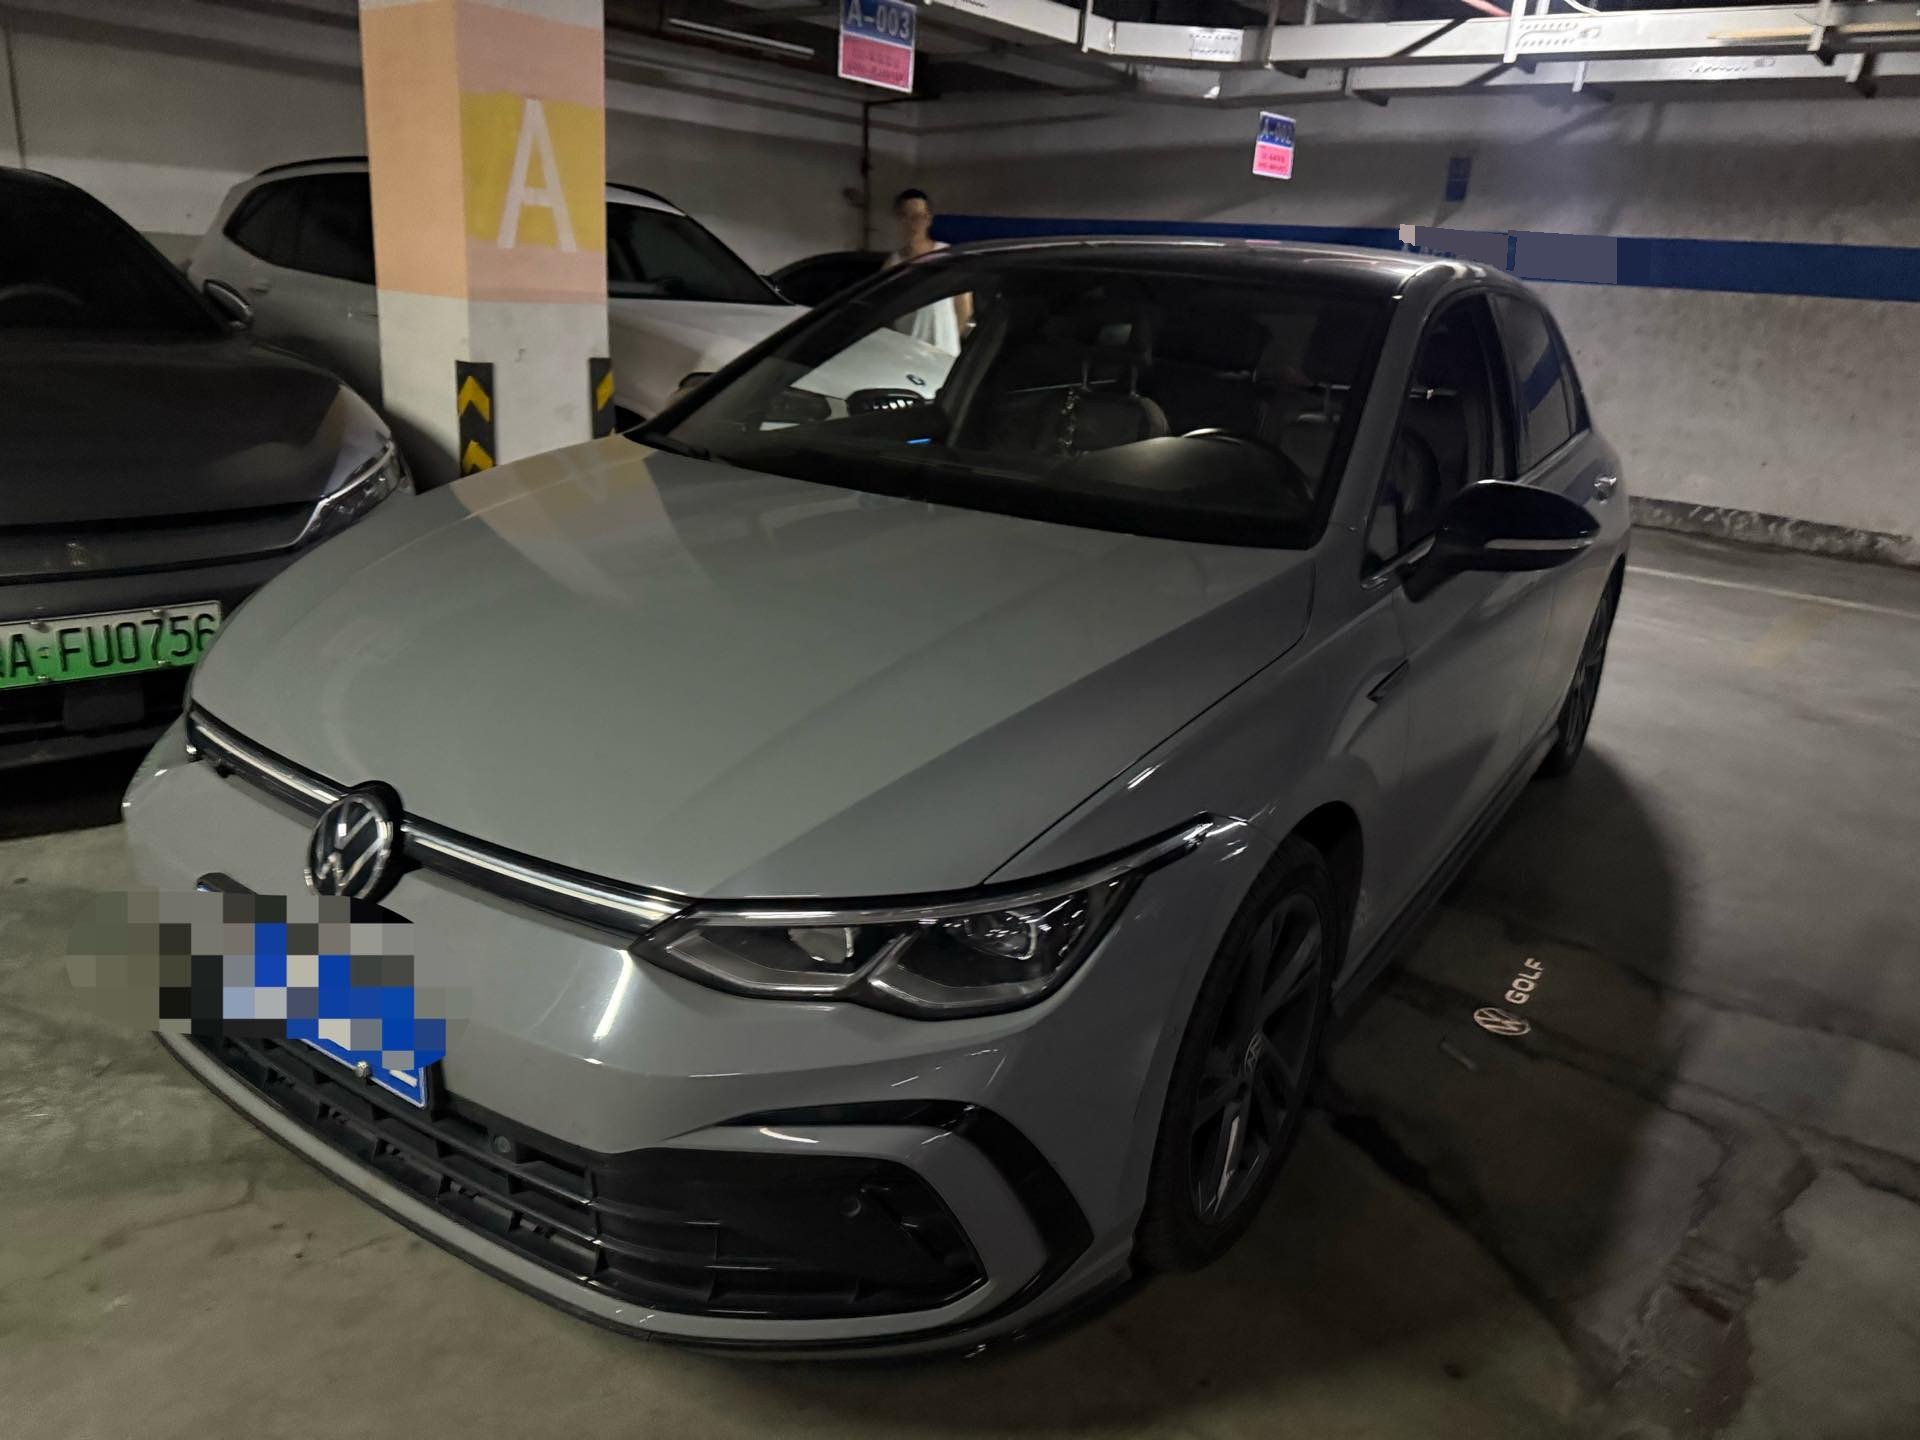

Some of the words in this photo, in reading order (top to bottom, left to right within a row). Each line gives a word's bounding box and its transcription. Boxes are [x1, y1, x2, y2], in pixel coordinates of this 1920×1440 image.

[847, 0, 911, 39] A-003
[497, 98, 577, 253] A
[1504, 957, 1545, 1005] GOLF
